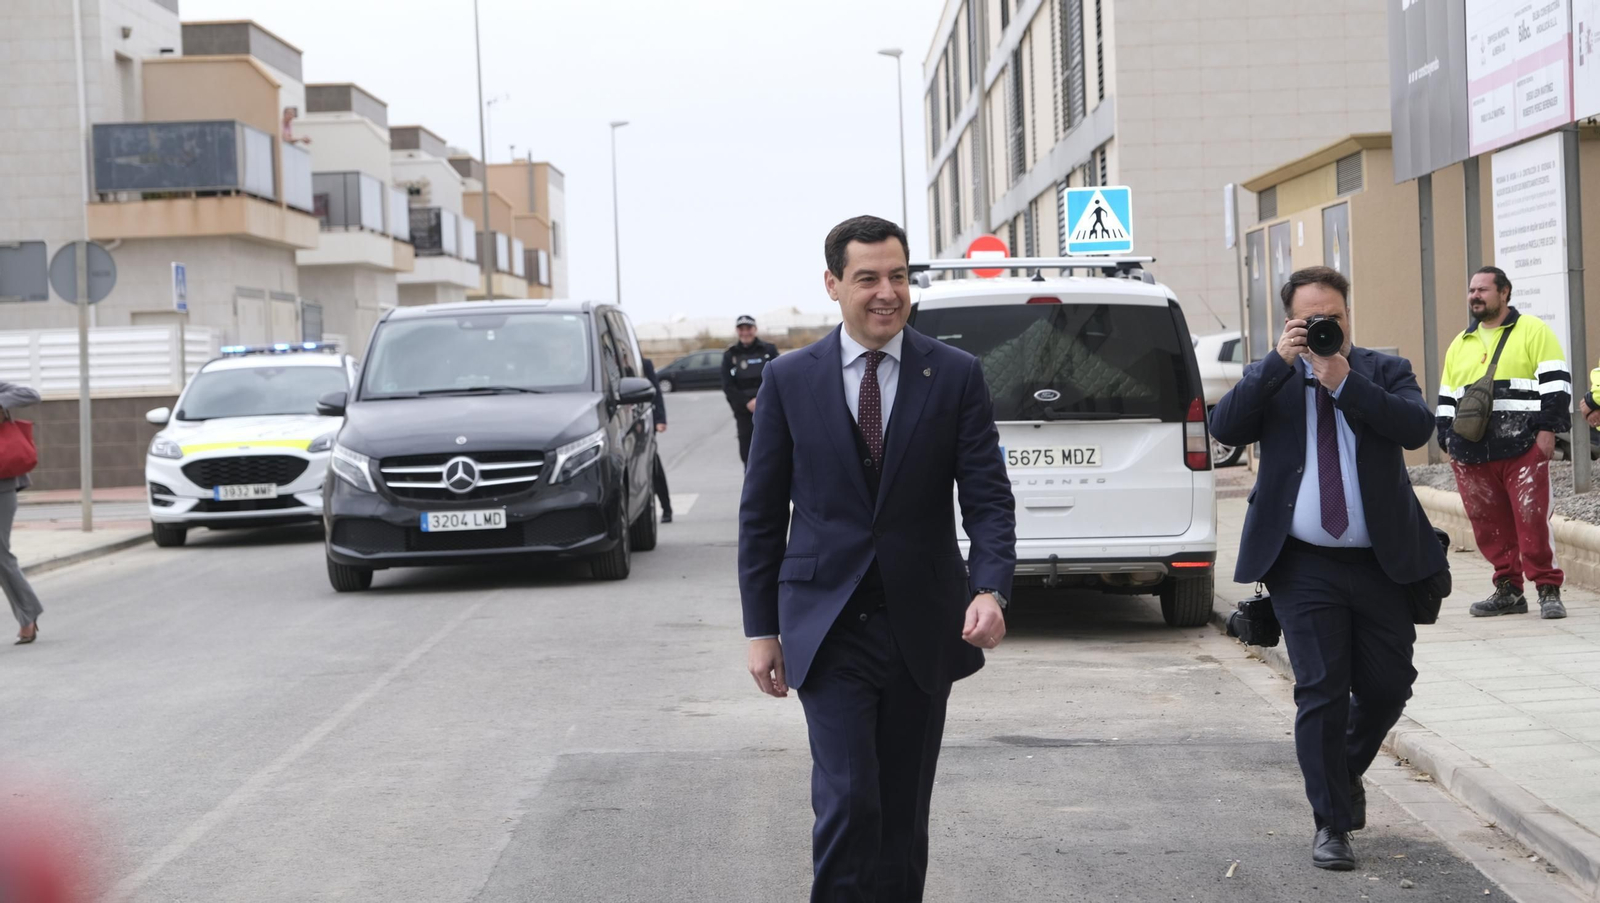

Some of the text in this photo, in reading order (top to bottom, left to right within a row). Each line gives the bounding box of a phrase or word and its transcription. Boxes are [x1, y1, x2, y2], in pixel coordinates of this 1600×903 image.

[1008, 448, 1096, 466] 5675 MDZ
[432, 512, 501, 529] 3204 LMD
